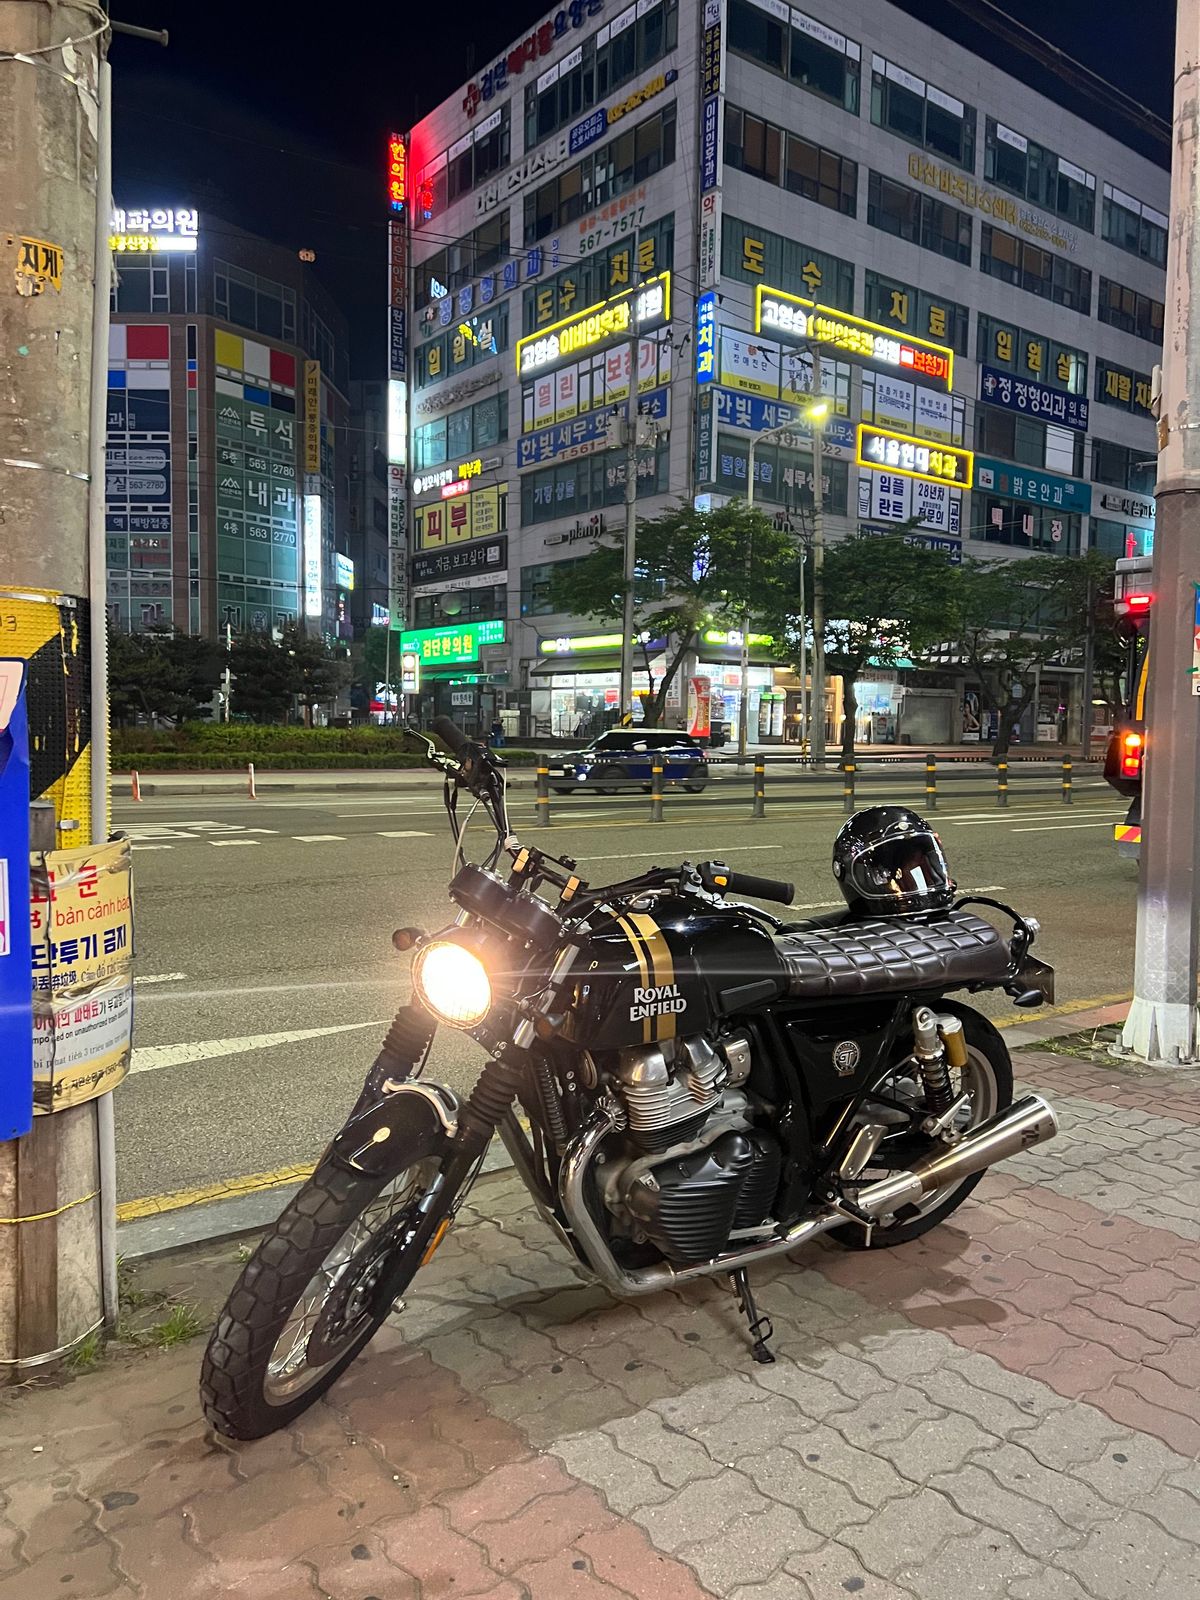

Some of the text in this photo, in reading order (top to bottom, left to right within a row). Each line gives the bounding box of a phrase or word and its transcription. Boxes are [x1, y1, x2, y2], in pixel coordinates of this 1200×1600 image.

[705, 101, 716, 177] 이비인후과
[579, 205, 646, 255] 567-7577
[22, 243, 64, 278] 지게
[698, 323, 713, 373] 치과
[996, 330, 1071, 383] 입원실
[914, 350, 948, 379] 보청기
[538, 373, 573, 409] 열린
[1105, 370, 1132, 401] 재활
[717, 391, 752, 428] 한빛
[1068, 401, 1088, 419] 의원
[246, 410, 293, 450] 투석
[520, 430, 554, 466] 한빛
[700, 413, 710, 481] 밝은안과
[868, 436, 957, 480] 서울현대치과
[249, 458, 267, 471] 563
[273, 463, 295, 477] 2780
[129, 480, 165, 490] 563-2780
[248, 480, 295, 513] 내과
[880, 475, 904, 497] 임플
[918, 483, 945, 502] 28년차
[1013, 476, 1064, 505] 밝은안과
[427, 502, 468, 542] 피부
[879, 498, 904, 519] 란트
[950, 502, 960, 532] 교정
[131, 518, 170, 530] 예방접종
[223, 522, 296, 544] 4층 563 2770
[991, 507, 1062, 542] 백내장
[423, 634, 473, 658] 검단한의원
[56, 906, 84, 927] bản
[88, 900, 116, 921] cảnh
[103, 923, 127, 955] 금지
[634, 984, 681, 1004] ROYAL
[629, 998, 688, 1022] ENFIELD
[65, 1031, 74, 1040] on
